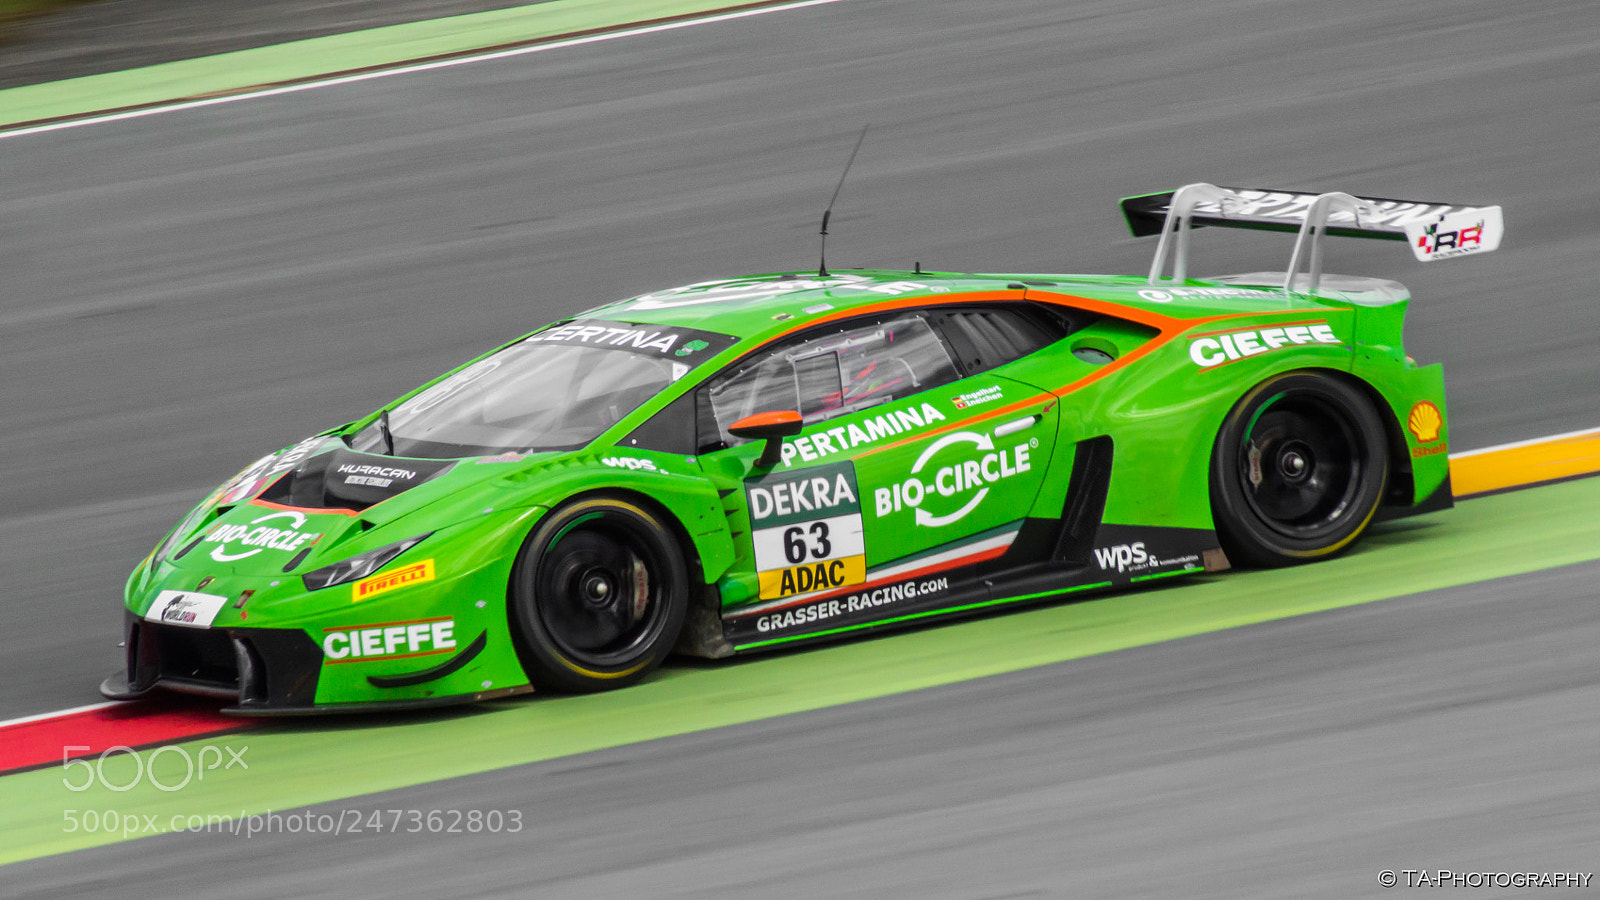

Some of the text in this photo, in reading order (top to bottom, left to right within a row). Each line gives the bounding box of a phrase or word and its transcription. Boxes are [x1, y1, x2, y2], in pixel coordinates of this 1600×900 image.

[525, 326, 679, 353] CERTINA
[1189, 324, 1343, 367] CIEFFE
[780, 402, 946, 467] PERTAMINA
[1412, 442, 1447, 458] Shell
[337, 464, 417, 480] HURACAN
[750, 473, 856, 520] DEKRA
[783, 521, 832, 564] 63
[1094, 541, 1148, 573] wps
[360, 564, 426, 596] PIRELLI
[780, 560, 845, 596] ADAC
[756, 577, 949, 632] GRASSER-RACING.COM
[323, 620, 457, 659] CIEFFE
